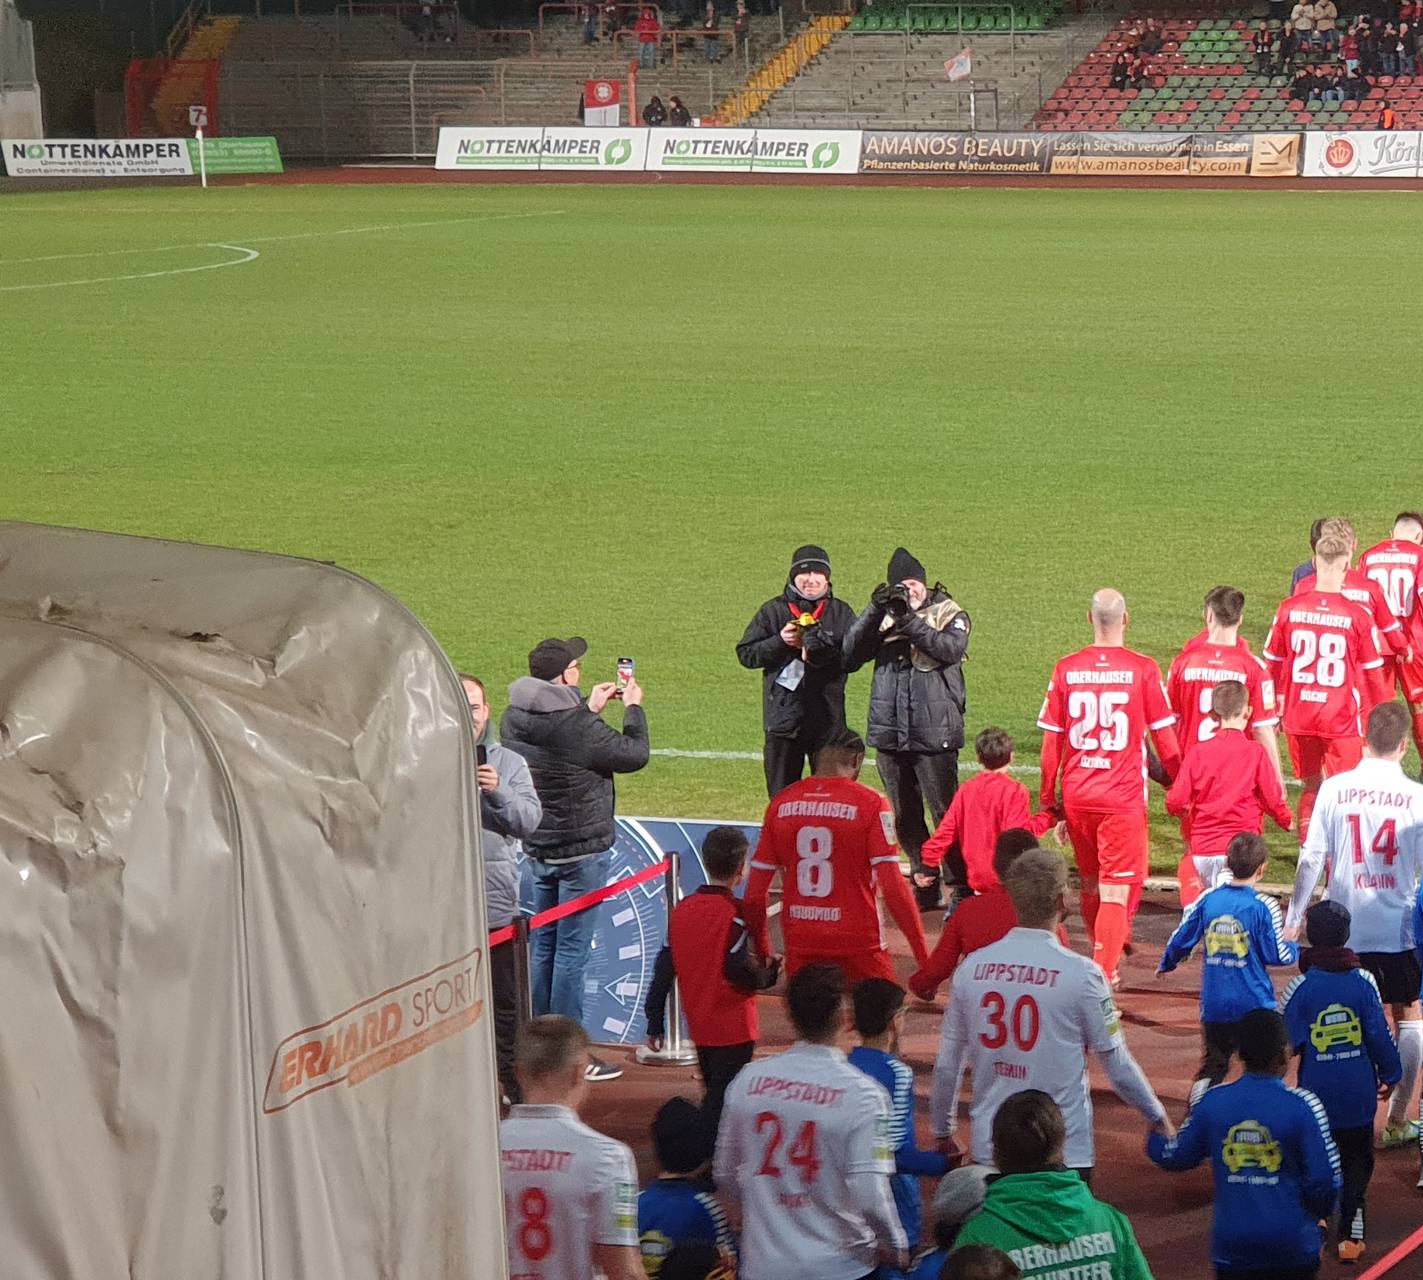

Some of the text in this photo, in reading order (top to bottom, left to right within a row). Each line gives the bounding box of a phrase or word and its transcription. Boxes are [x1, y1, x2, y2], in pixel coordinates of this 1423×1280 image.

[12, 140, 181, 159] NOTTENKÄMPER
[458, 136, 600, 155] NOTTENKÄMPER
[865, 135, 1043, 157] AMANOS BEAUTY
[1215, 141, 1249, 153] Essen
[863, 159, 1041, 172] Pflanzenbasierte Naturkosmetik
[1289, 610, 1352, 629] OBERHAUSEN
[1291, 629, 1346, 687] 28
[1066, 671, 1133, 685] OBERHAUSEN
[1068, 691, 1129, 751] 25
[778, 800, 858, 820] OBERHAUSEN
[1337, 788, 1413, 809] LIPPSTADT
[1346, 813, 1399, 866] 14
[796, 826, 833, 898] 8
[974, 963, 1061, 988] LIPPSTADT
[279, 1002, 403, 1094] ERHARD
[412, 967, 473, 1028] SPORT
[978, 991, 1040, 1052] 30
[754, 1111, 823, 1185] 24
[1007, 1231, 1117, 1272] BERHAUSEN
